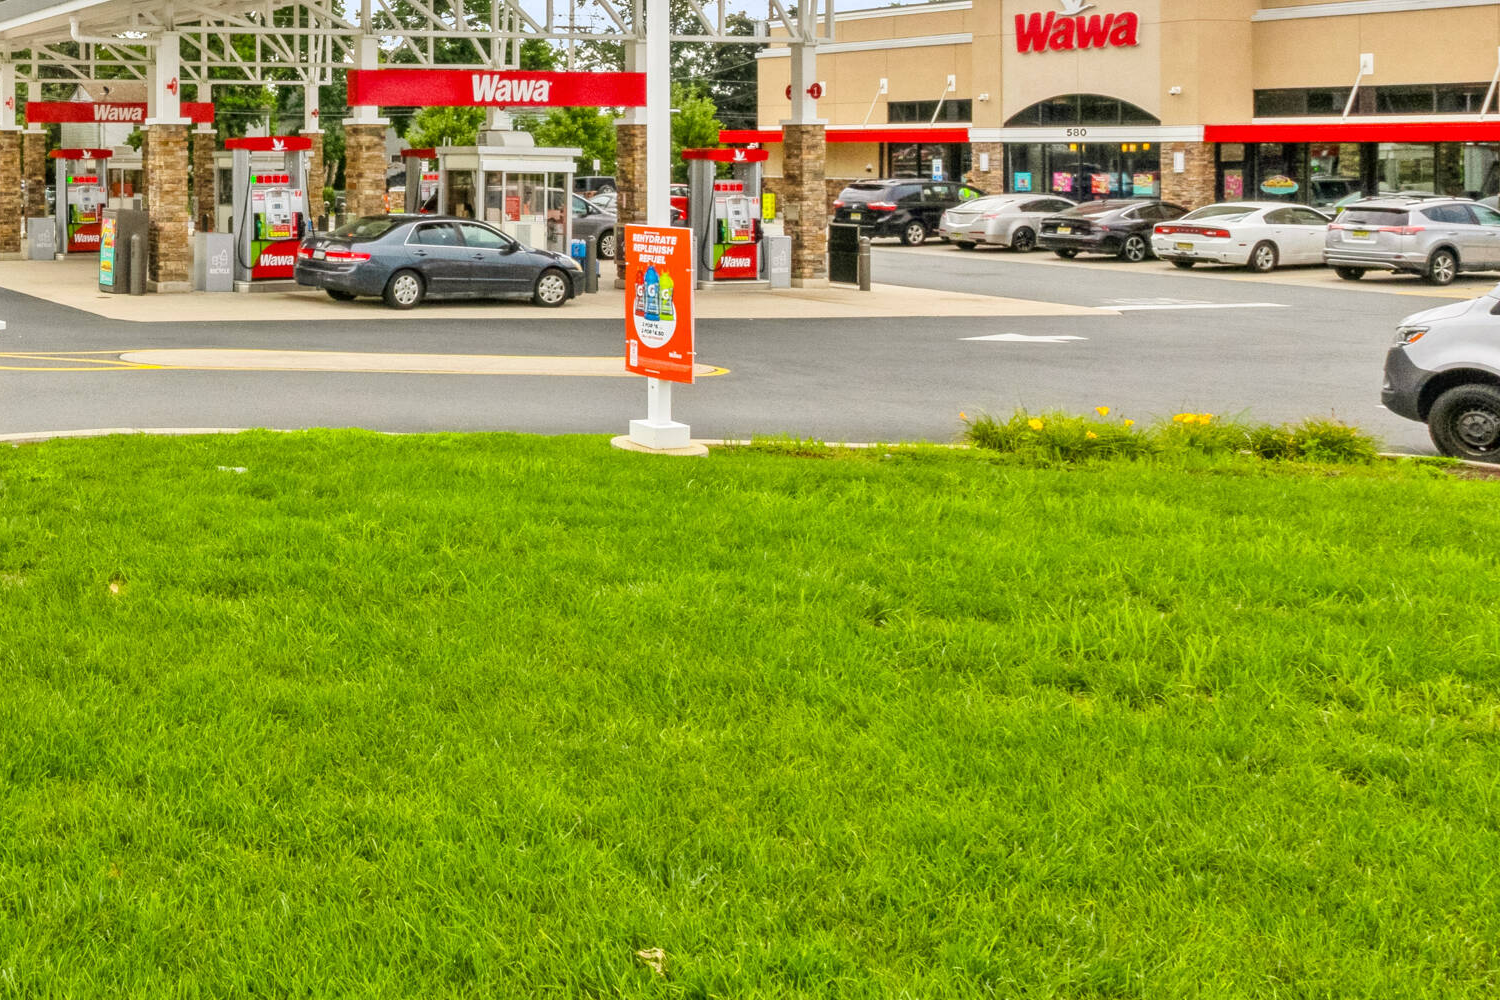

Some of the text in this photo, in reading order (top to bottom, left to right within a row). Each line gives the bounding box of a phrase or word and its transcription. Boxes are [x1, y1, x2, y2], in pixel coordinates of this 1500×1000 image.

[1014, 10, 1140, 54] Wawa
[471, 74, 550, 103] Wawa
[93, 104, 143, 121] Wawa
[1066, 128, 1087, 137] 580
[74, 233, 100, 243] Wawa
[632, 233, 678, 246] REHYDRATE
[632, 243, 675, 256] REPLENISH
[259, 254, 295, 267] Wawa
[638, 254, 667, 265] REFUEL
[720, 256, 751, 268] Wawa
